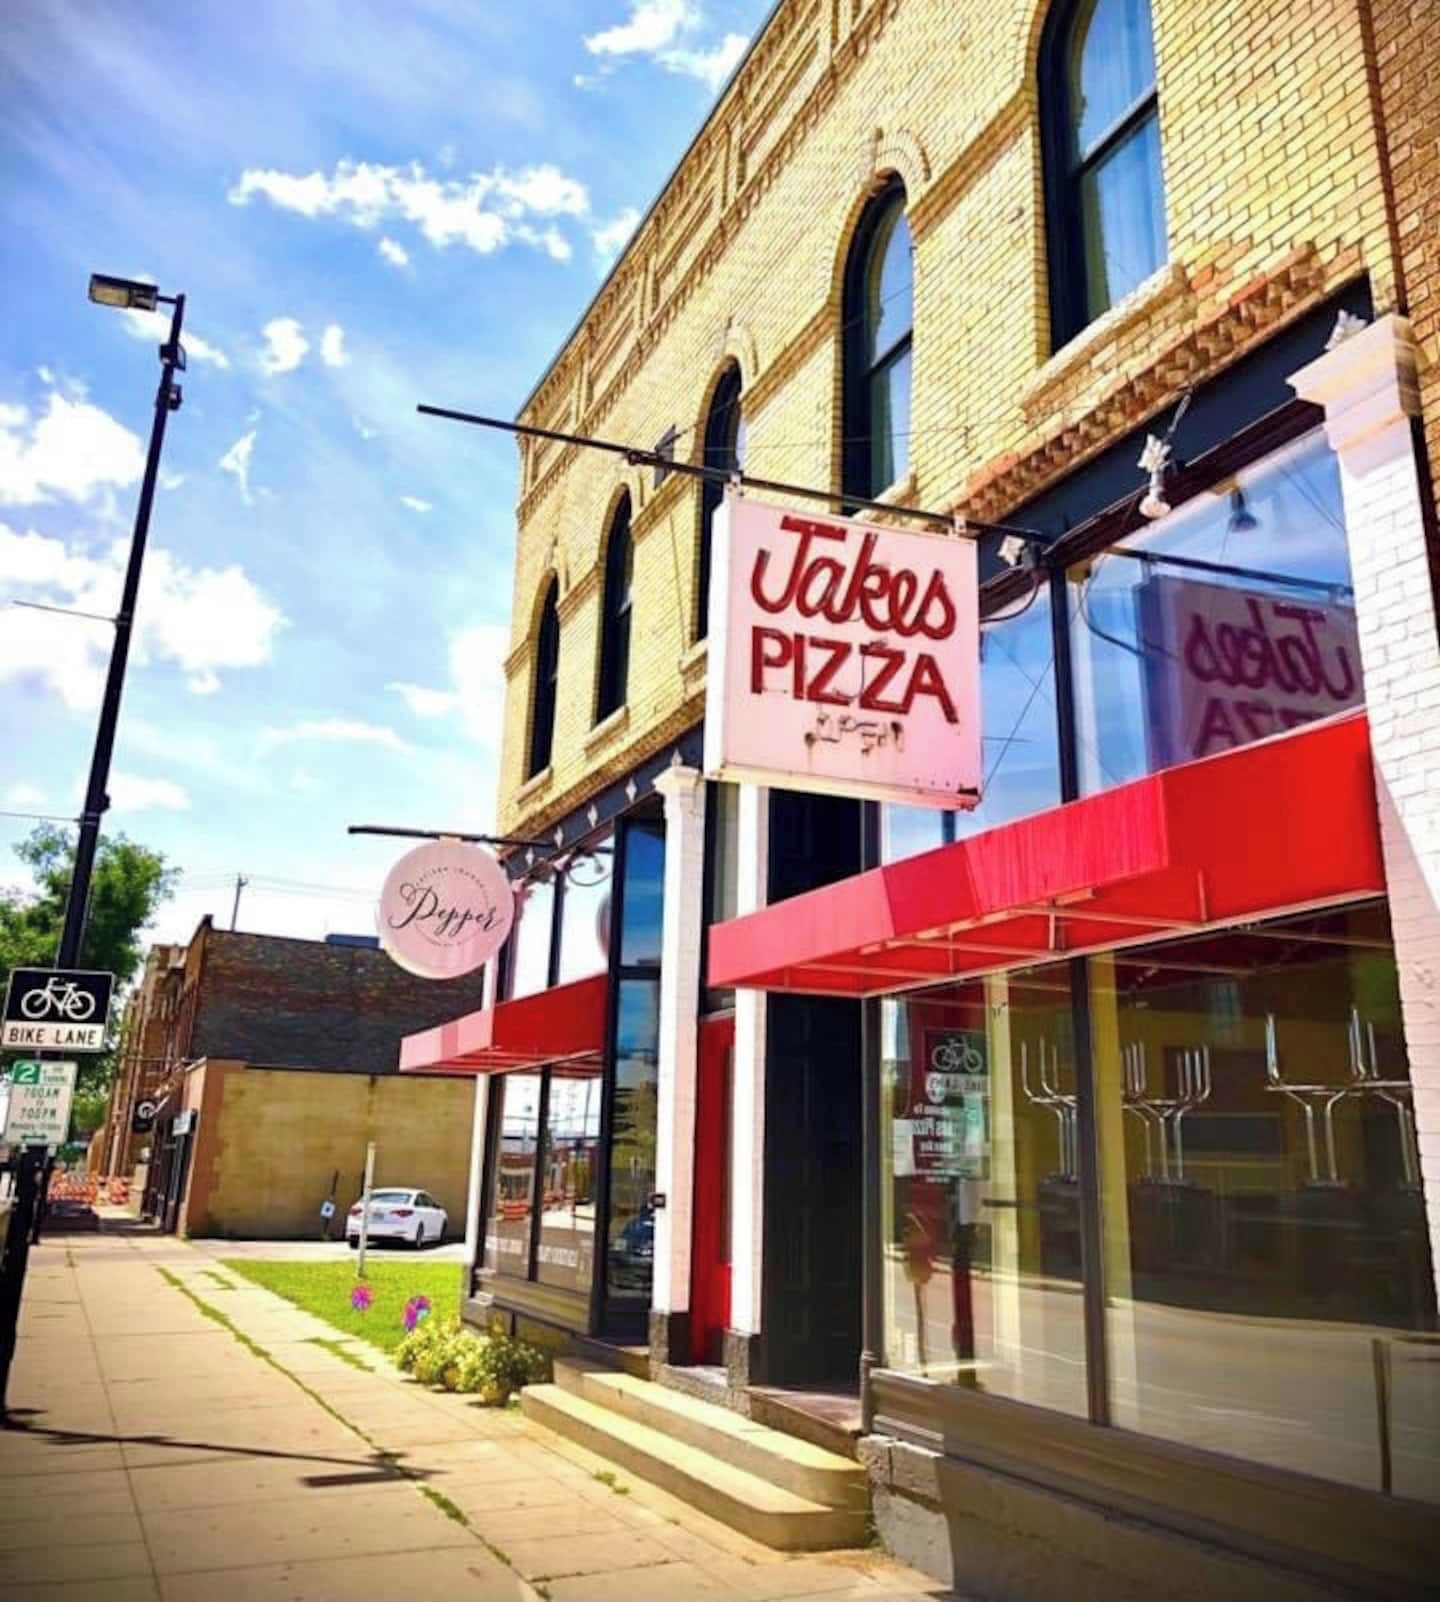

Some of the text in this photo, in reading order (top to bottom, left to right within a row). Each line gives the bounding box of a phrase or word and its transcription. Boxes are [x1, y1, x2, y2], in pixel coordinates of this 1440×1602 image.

[750, 515, 957, 640] Jakes
[750, 625, 959, 724] PIZZA
[388, 882, 503, 938] Pepper
[9, 1027, 97, 1045] BIKE LANE
[18, 1064, 37, 1082] 2
